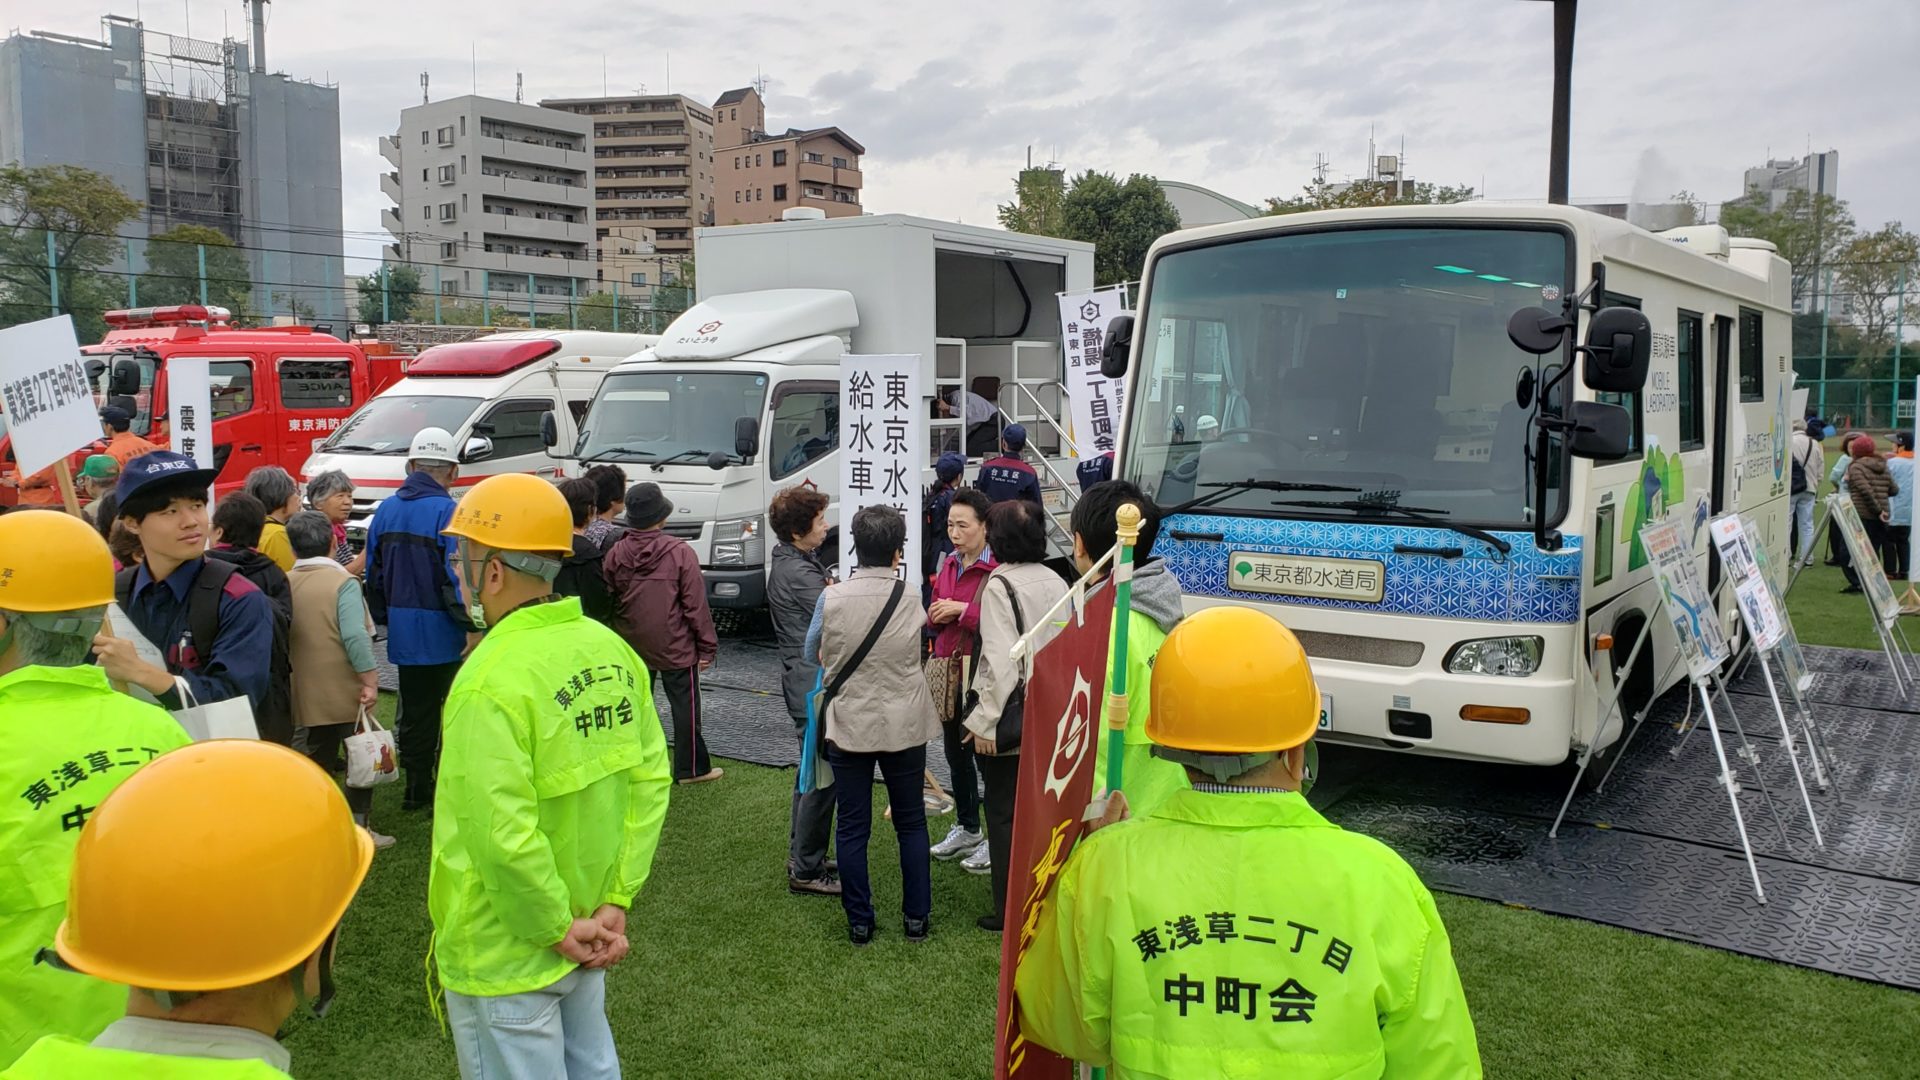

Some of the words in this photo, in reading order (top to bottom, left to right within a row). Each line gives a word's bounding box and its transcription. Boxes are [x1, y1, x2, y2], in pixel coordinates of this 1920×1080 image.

[3, 359, 89, 427] 東浅草2丁目中町会
[145, 460, 191, 474] 台東区
[1254, 562, 1377, 592] 東京都水道局
[553, 663, 635, 711] 東浅草二丁目
[575, 696, 634, 738] 中町会
[1131, 911, 1354, 975] 東浅草二丁目
[1164, 973, 1318, 1024] 中町会
